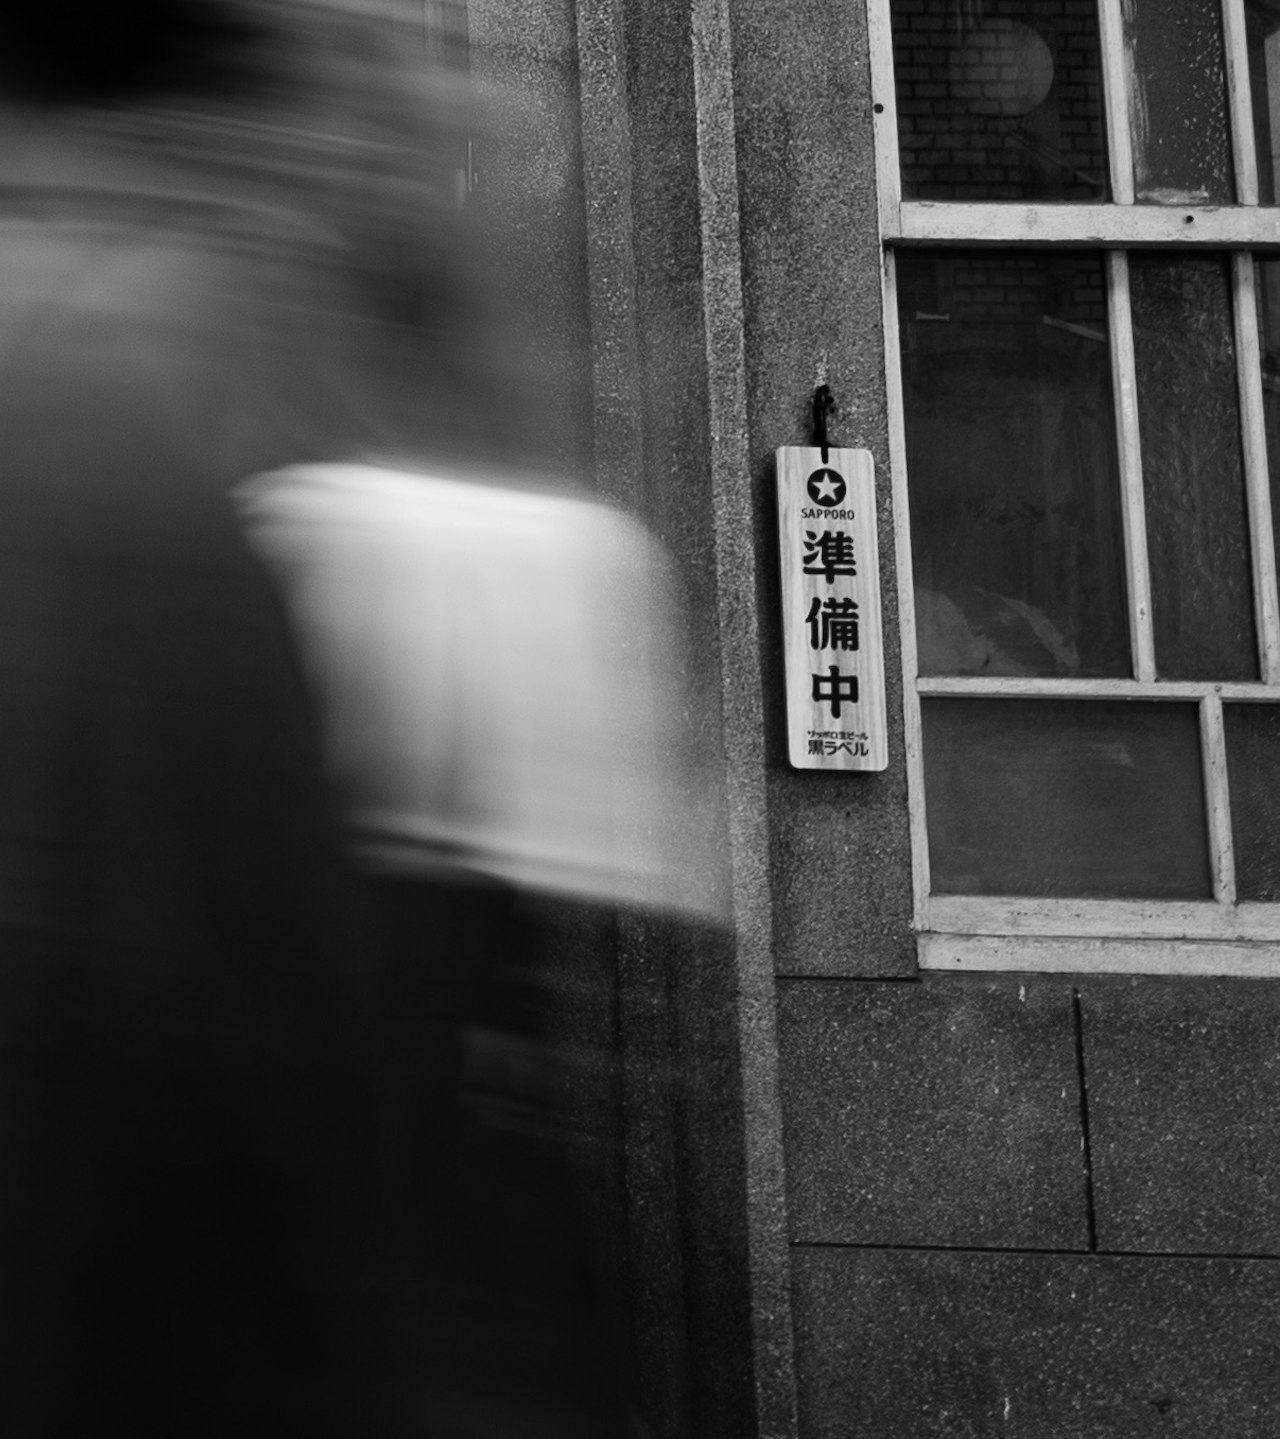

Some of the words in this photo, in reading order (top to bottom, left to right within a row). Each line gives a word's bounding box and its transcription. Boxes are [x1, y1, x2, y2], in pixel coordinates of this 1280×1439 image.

[801, 507, 855, 521] SAPPORO
[802, 530, 860, 720] 準備中
[807, 730, 869, 740] サッポロ生ビール
[807, 740, 870, 756] 黒ラベル
